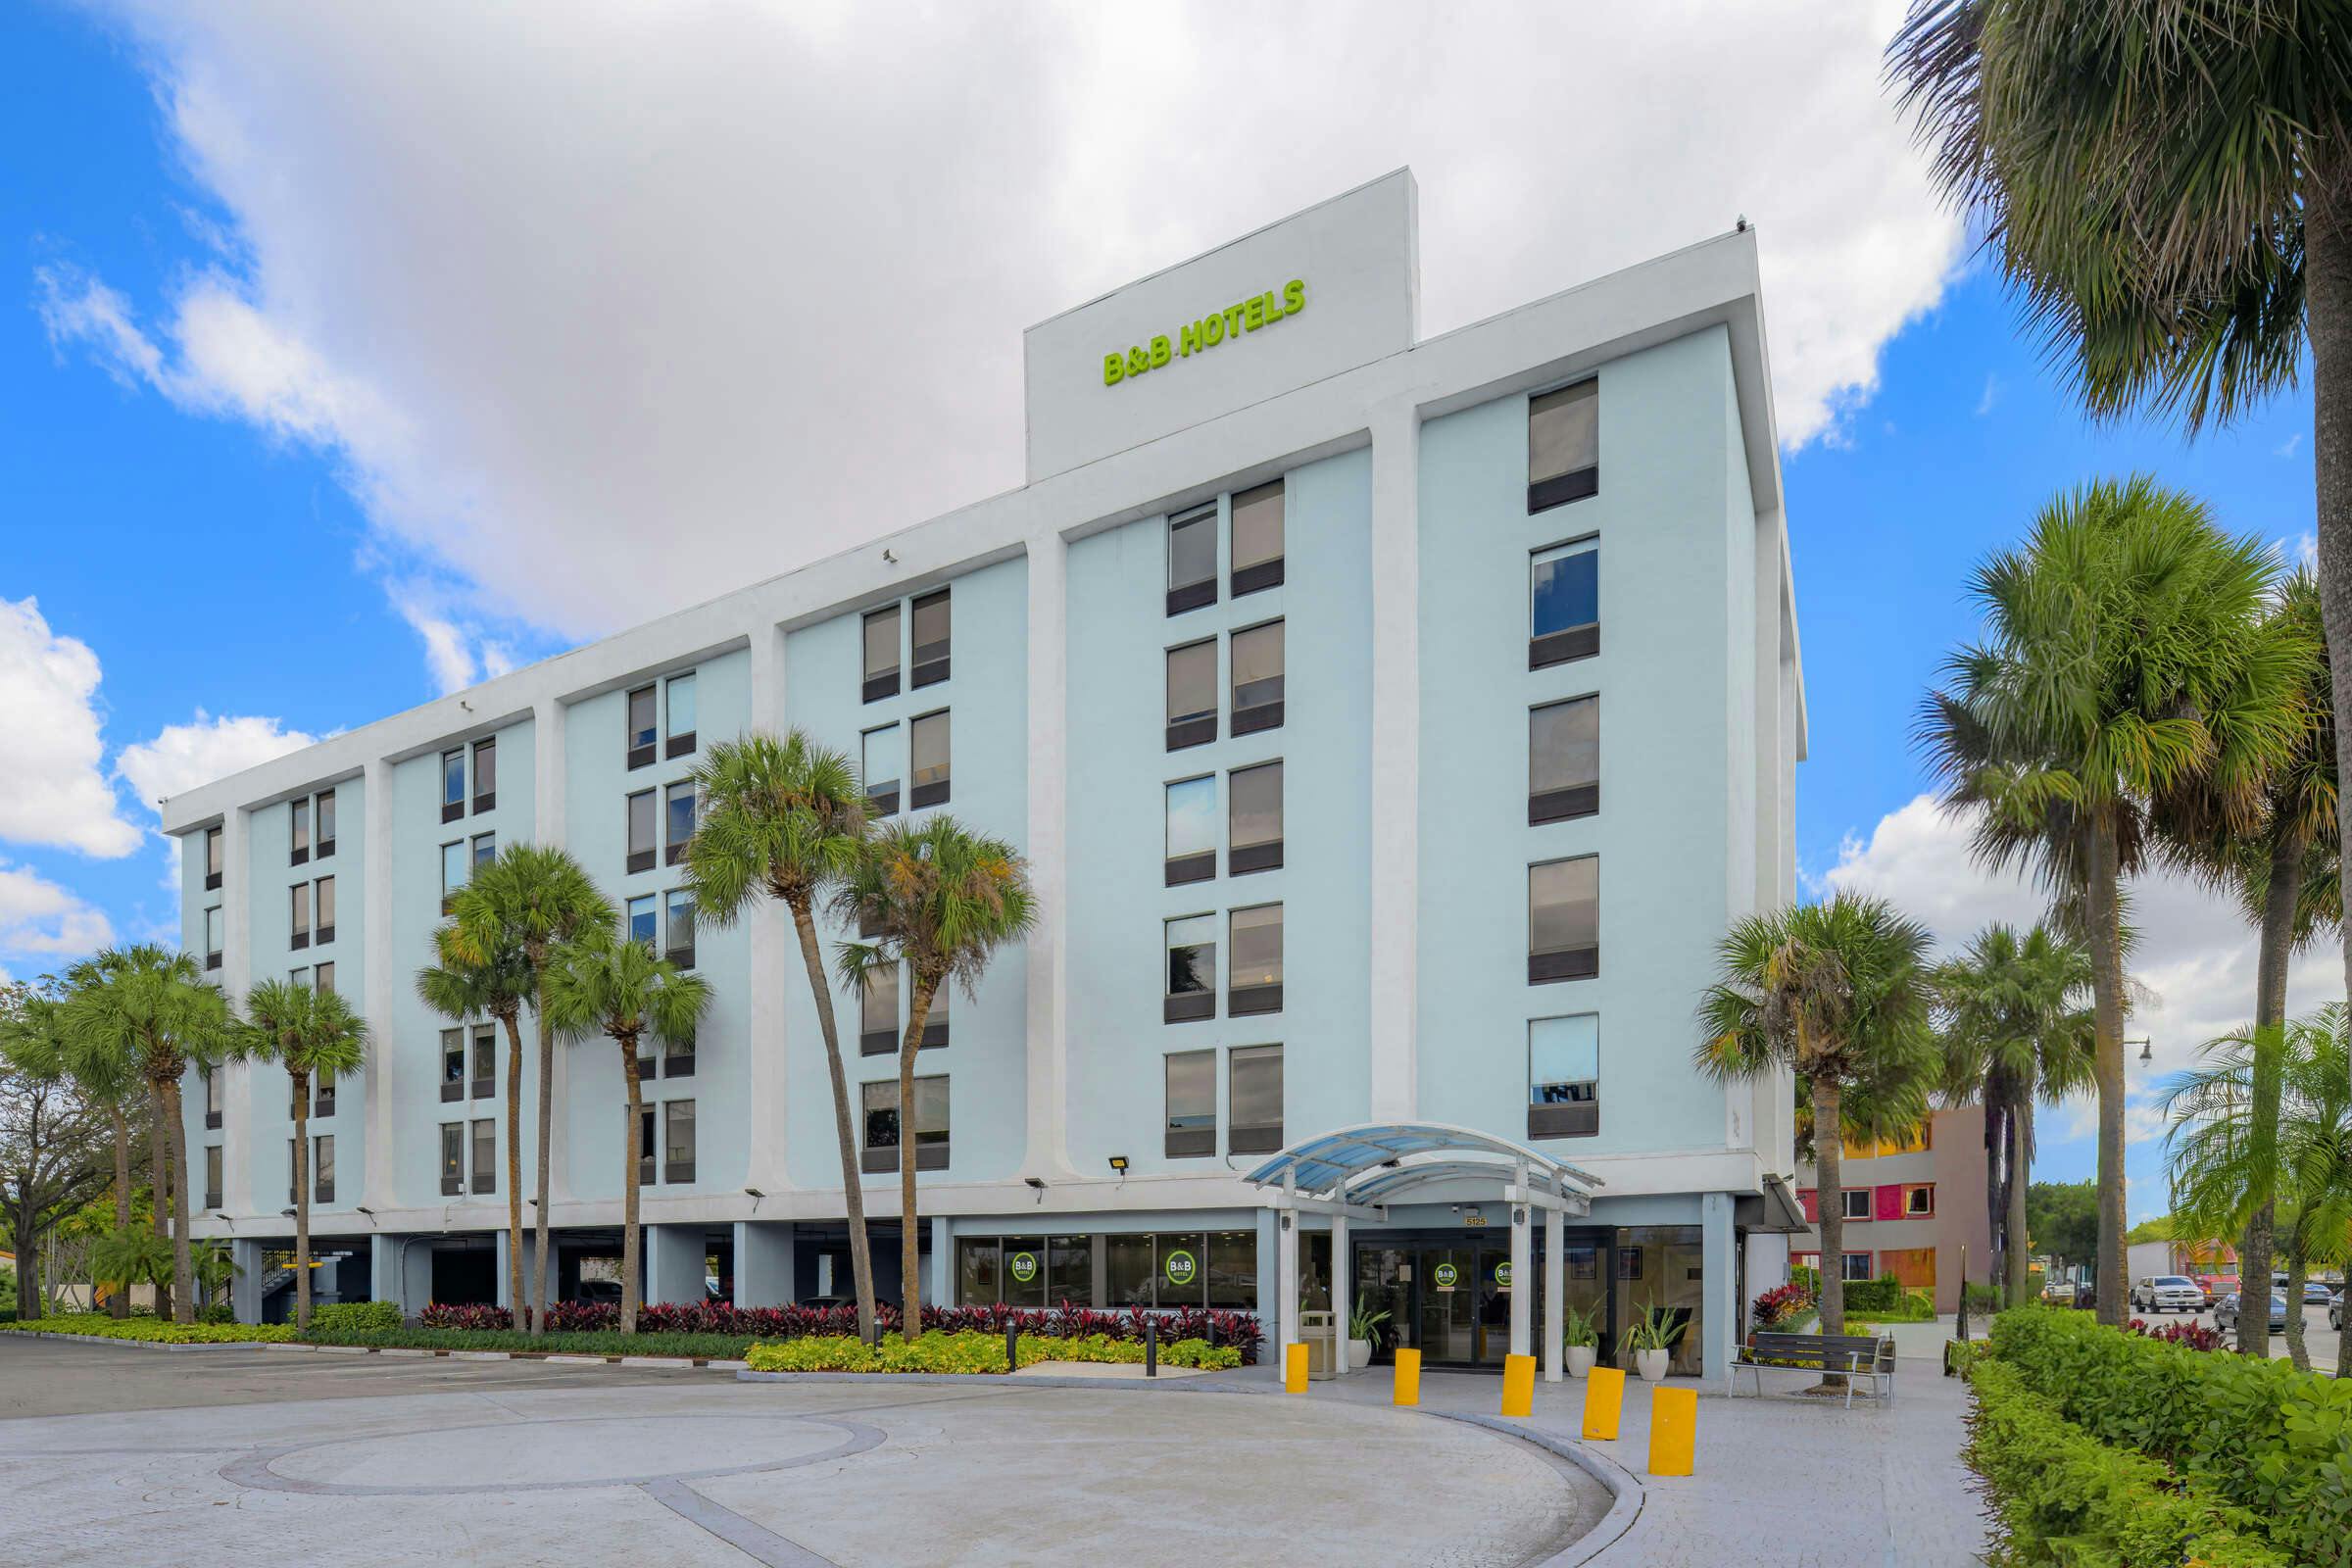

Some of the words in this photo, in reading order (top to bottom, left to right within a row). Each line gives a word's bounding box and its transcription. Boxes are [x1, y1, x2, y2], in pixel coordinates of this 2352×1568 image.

[1103, 335, 1172, 387] B&B
[1180, 279, 1305, 359] HOTELS
[1015, 1260, 1033, 1270] B&B
[1170, 1260, 1192, 1271] B&B
